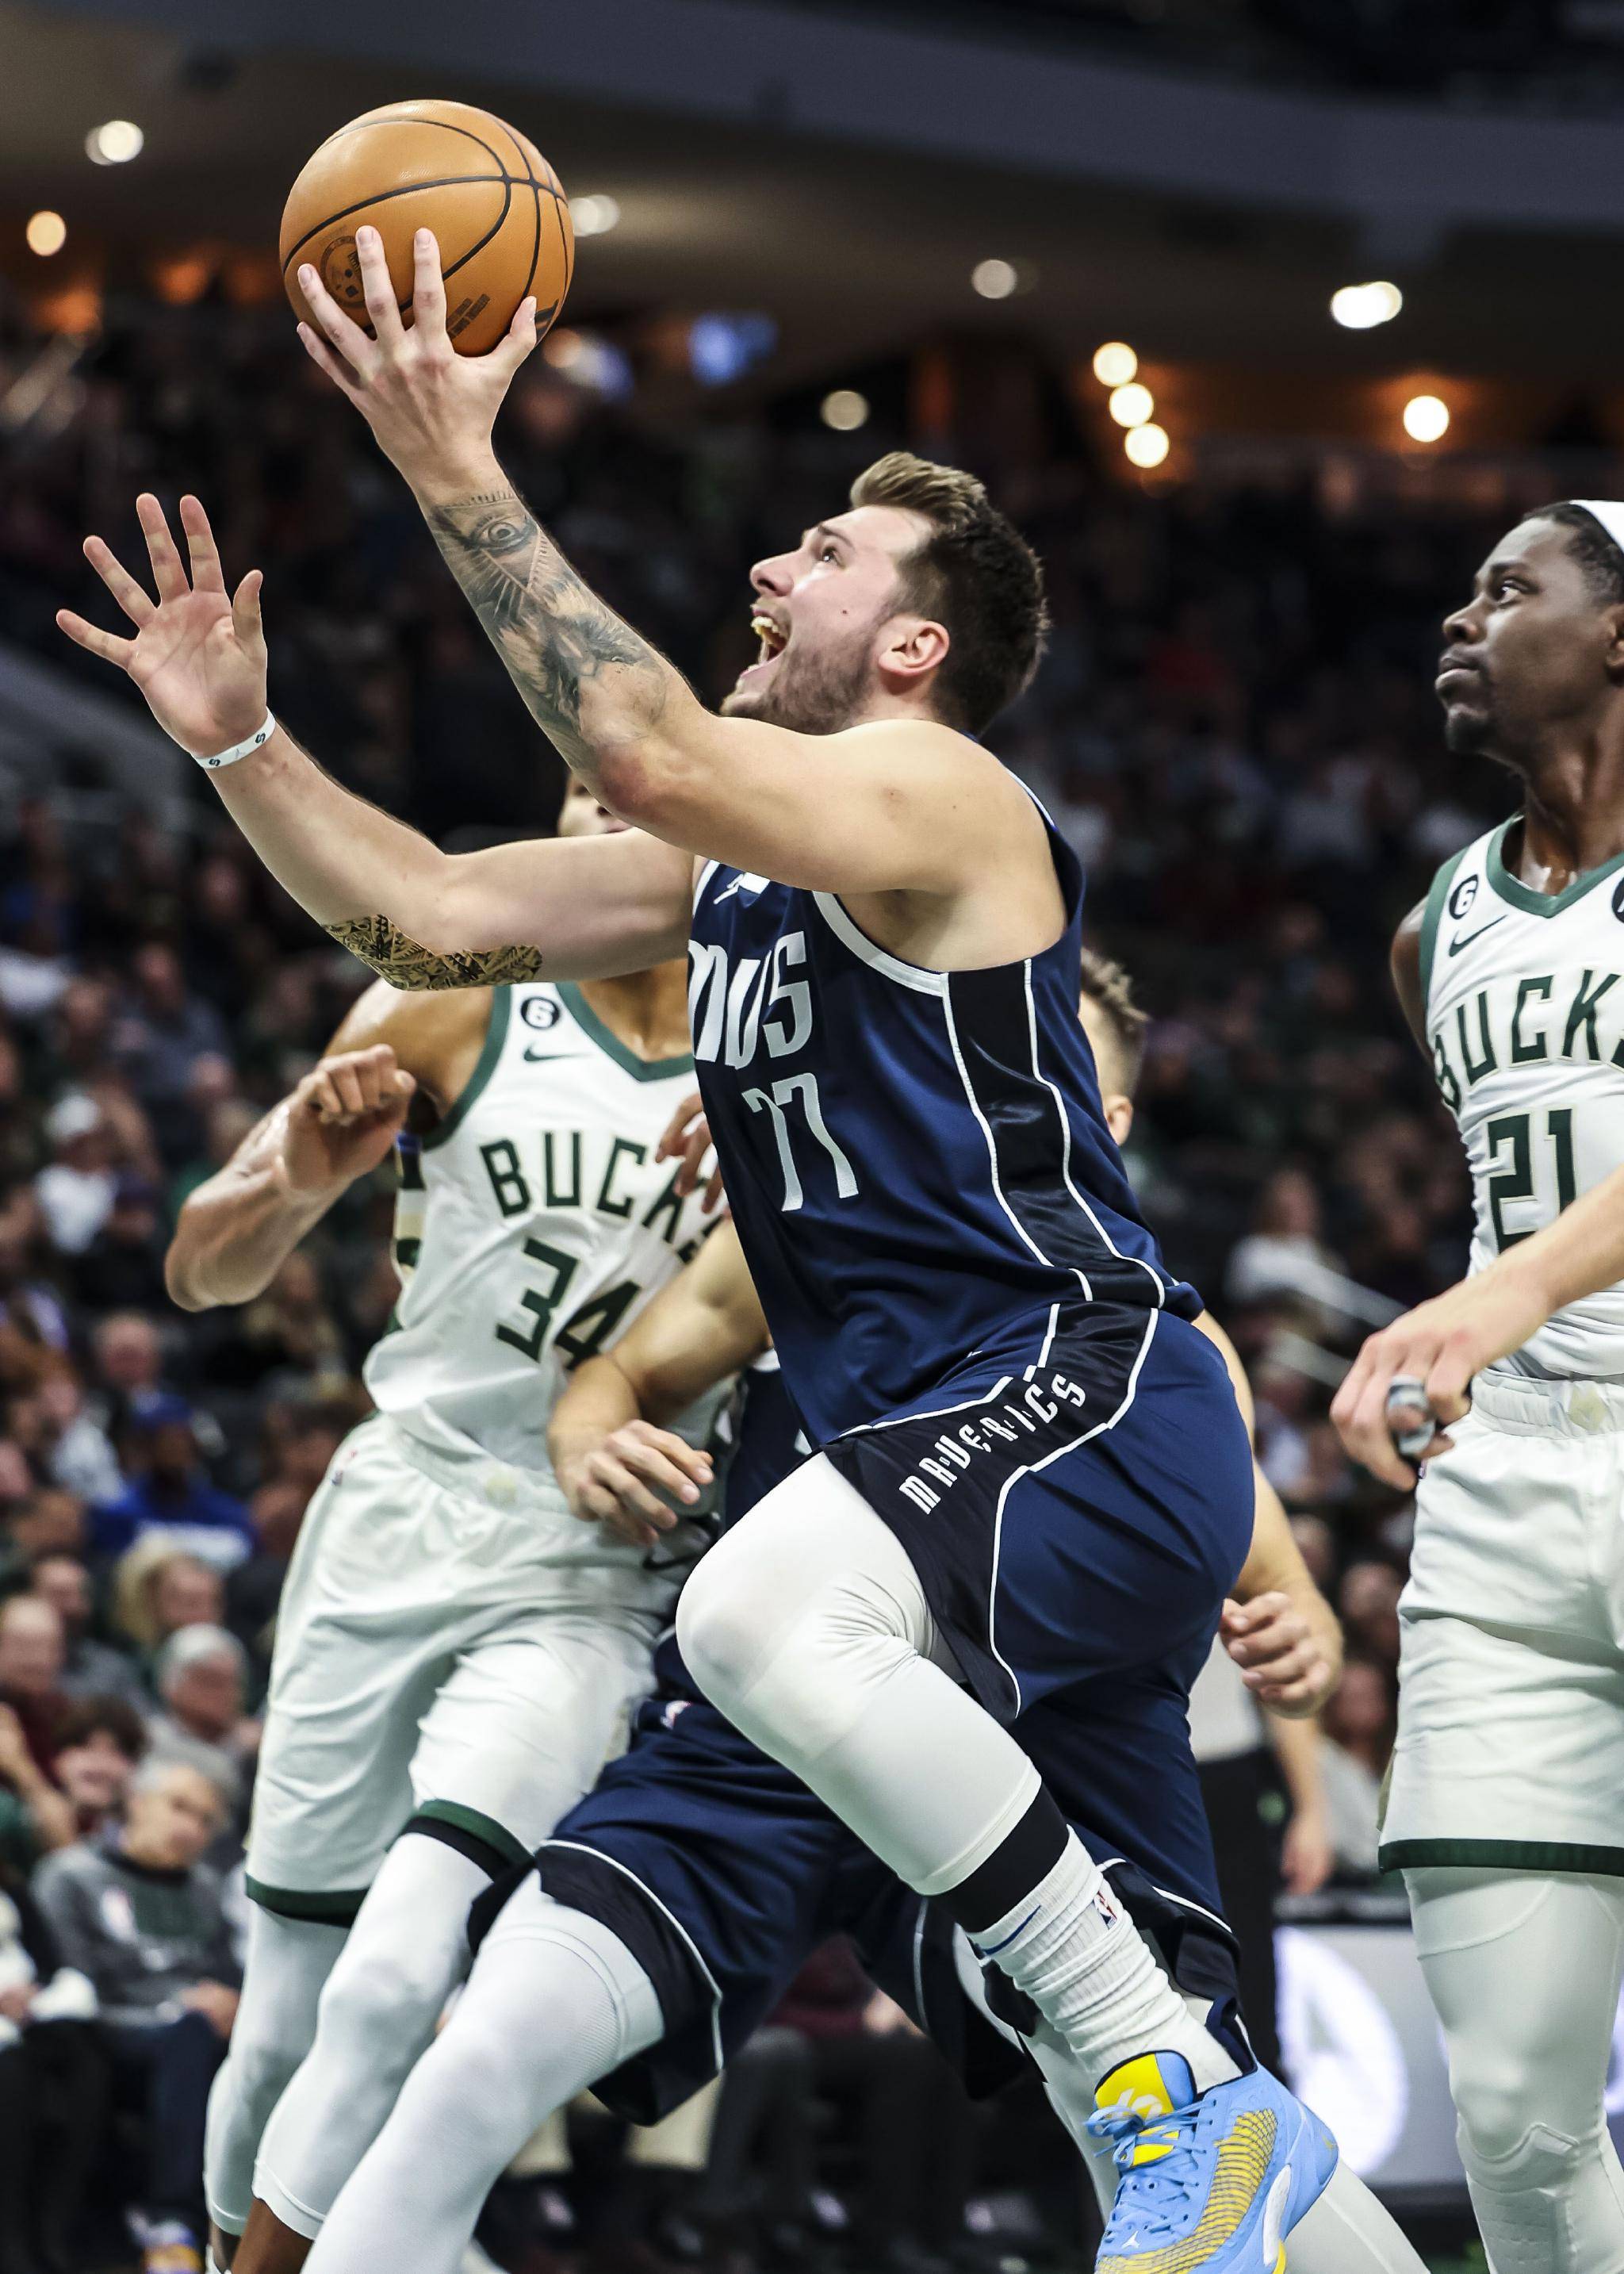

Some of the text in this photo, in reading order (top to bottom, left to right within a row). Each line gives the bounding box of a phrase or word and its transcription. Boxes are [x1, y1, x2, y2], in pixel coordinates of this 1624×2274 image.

[1453, 878, 1477, 916] 6
[525, 999, 556, 1027] 6
[1435, 968, 1624, 1115] BUCK
[741, 1072, 859, 1211] 77
[1488, 1109, 1576, 1256] 21
[496, 1237, 641, 1371] 34
